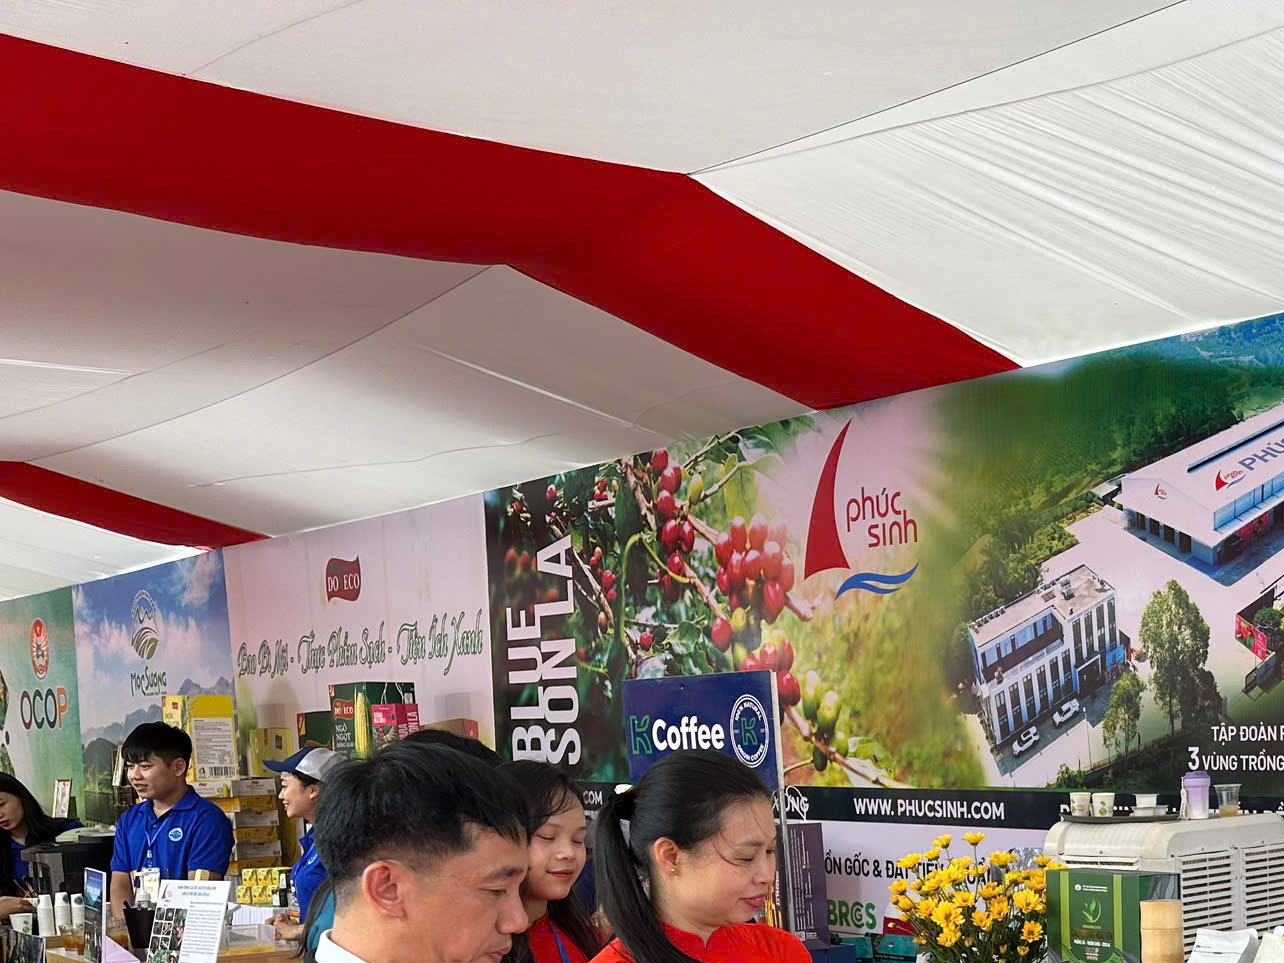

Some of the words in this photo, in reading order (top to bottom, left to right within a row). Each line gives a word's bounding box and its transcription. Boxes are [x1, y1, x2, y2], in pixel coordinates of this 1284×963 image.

[847, 487, 901, 532] phúc
[868, 510, 917, 548] sinh
[344, 573, 360, 590] ECO
[535, 534, 574, 617] LA
[444, 609, 483, 676] Xanh
[506, 607, 548, 762] BLUE
[21, 687, 67, 730] OCOP
[652, 716, 725, 750] Coffee
[741, 717, 757, 745] K
[1211, 725, 1236, 746] TẬP
[1240, 725, 1278, 742] ĐOÀN
[1188, 746, 1199, 771] 3
[1202, 752, 1237, 771] VÙNG
[1240, 749, 1284, 771] TRỒNG
[854, 798, 894, 816] WWW.
[897, 799, 1005, 820] PHUCSINH.COM
[845, 853, 869, 876] GỐC
[873, 862, 882, 877] &
